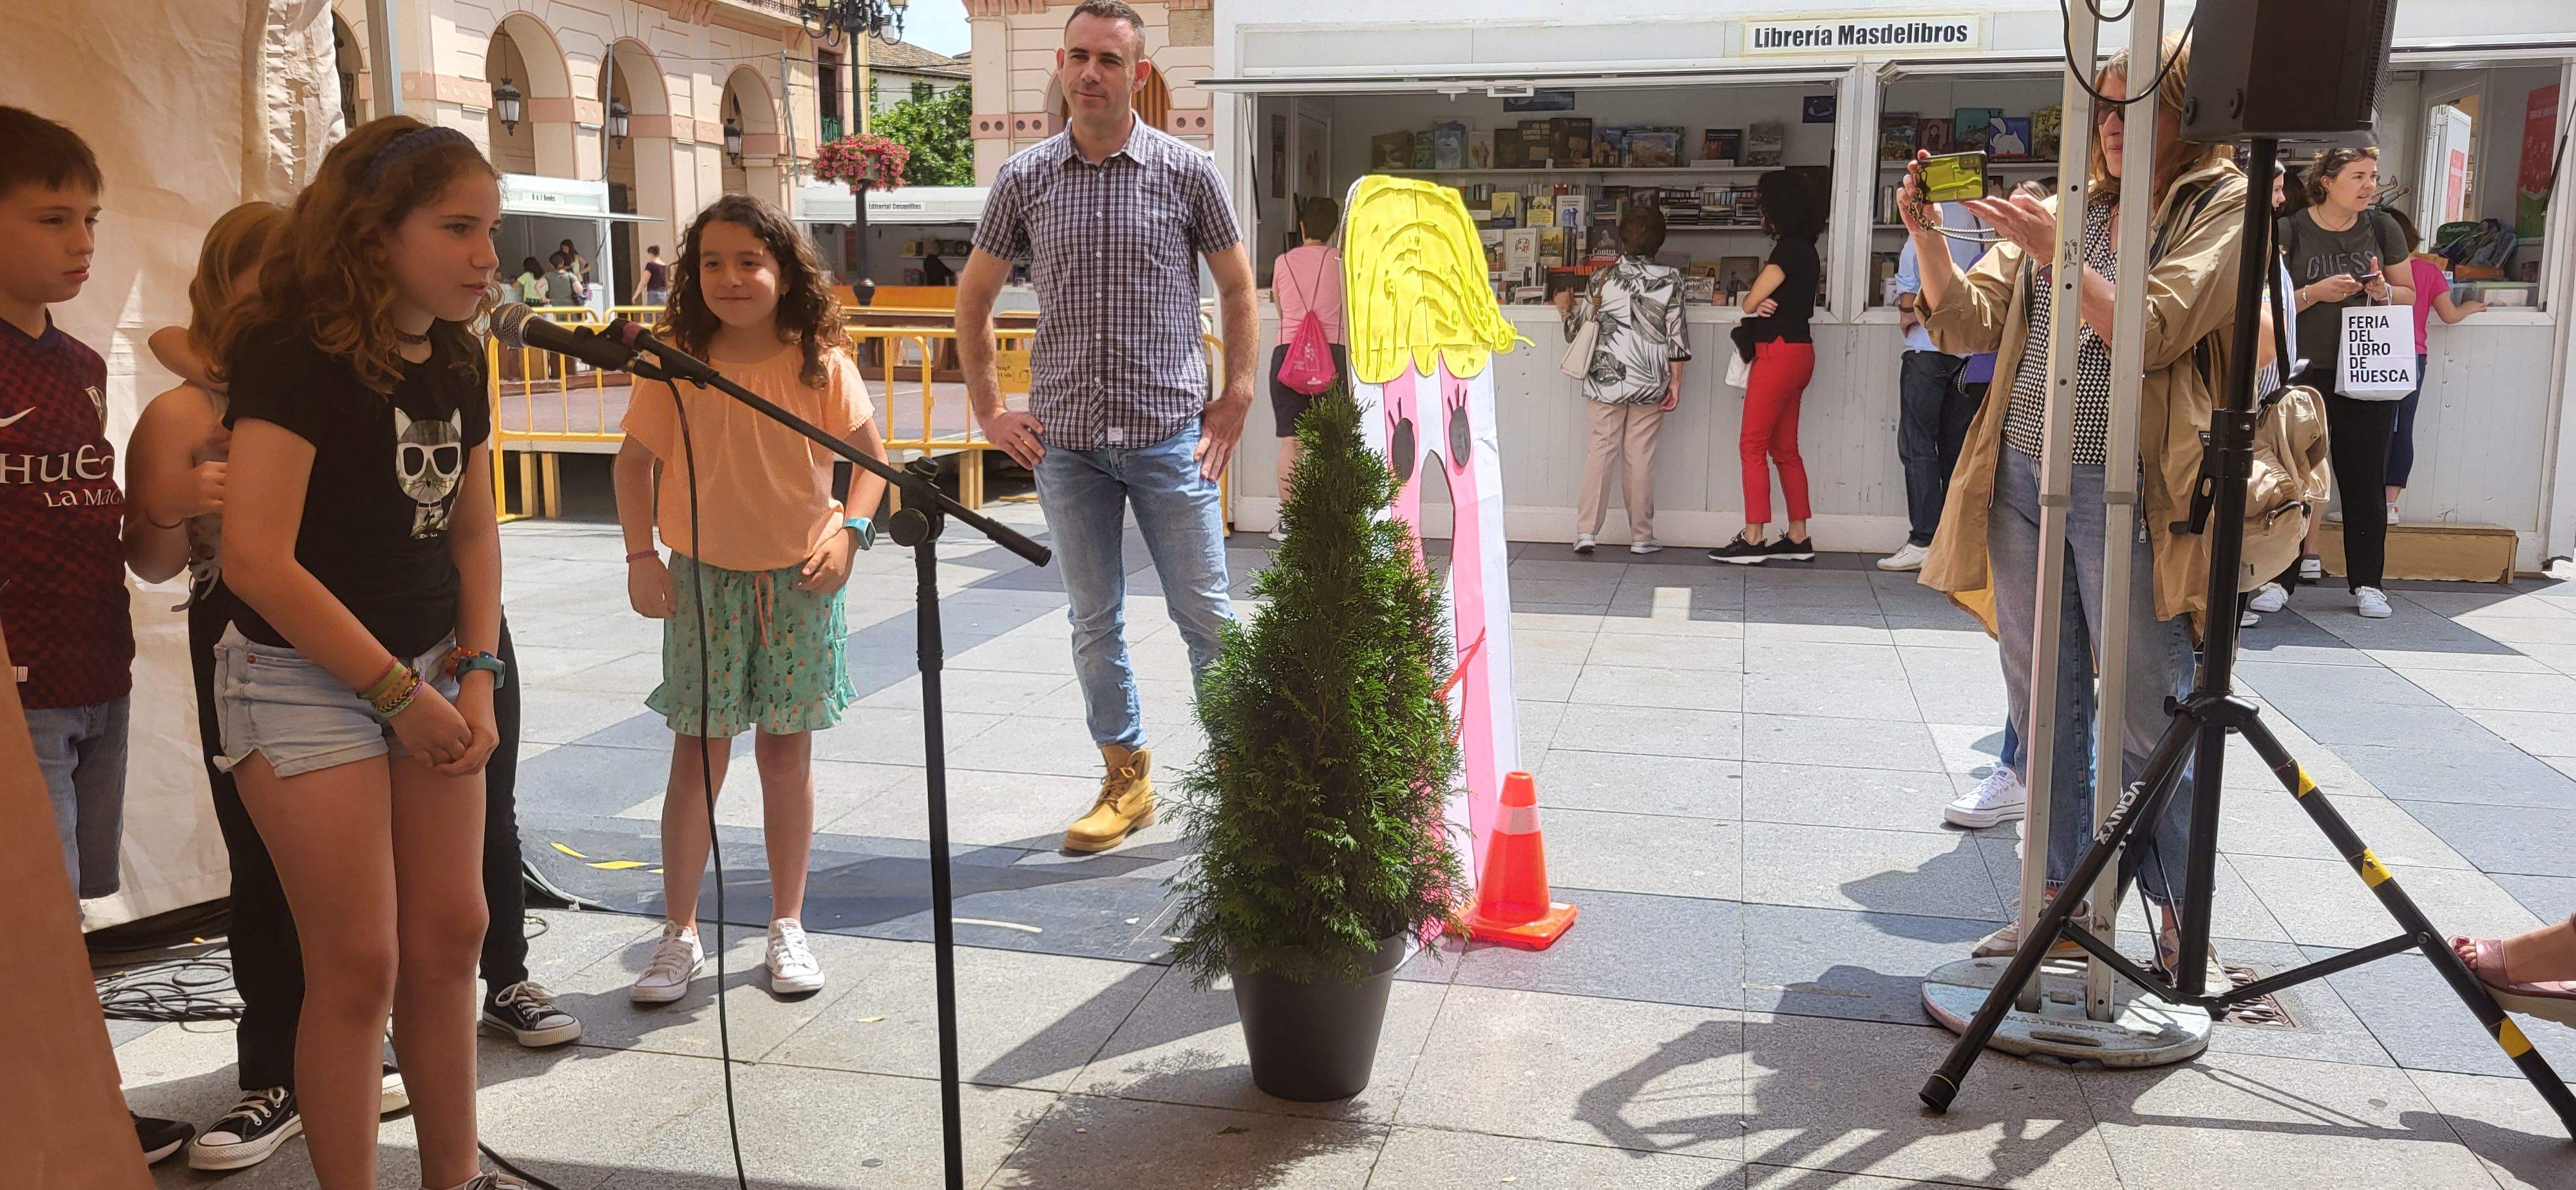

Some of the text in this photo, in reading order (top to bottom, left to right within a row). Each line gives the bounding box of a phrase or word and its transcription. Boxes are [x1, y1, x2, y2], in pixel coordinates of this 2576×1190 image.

[1754, 23, 1968, 48] Librería Masdelibros
[2348, 316, 2390, 329] FERIA
[2349, 330, 2374, 343] DEL
[2349, 343, 2391, 356] LIBRO
[2349, 357, 2367, 369] DE
[2350, 369, 2409, 382] HUESCA
[2093, 781, 2146, 845] VONYX
